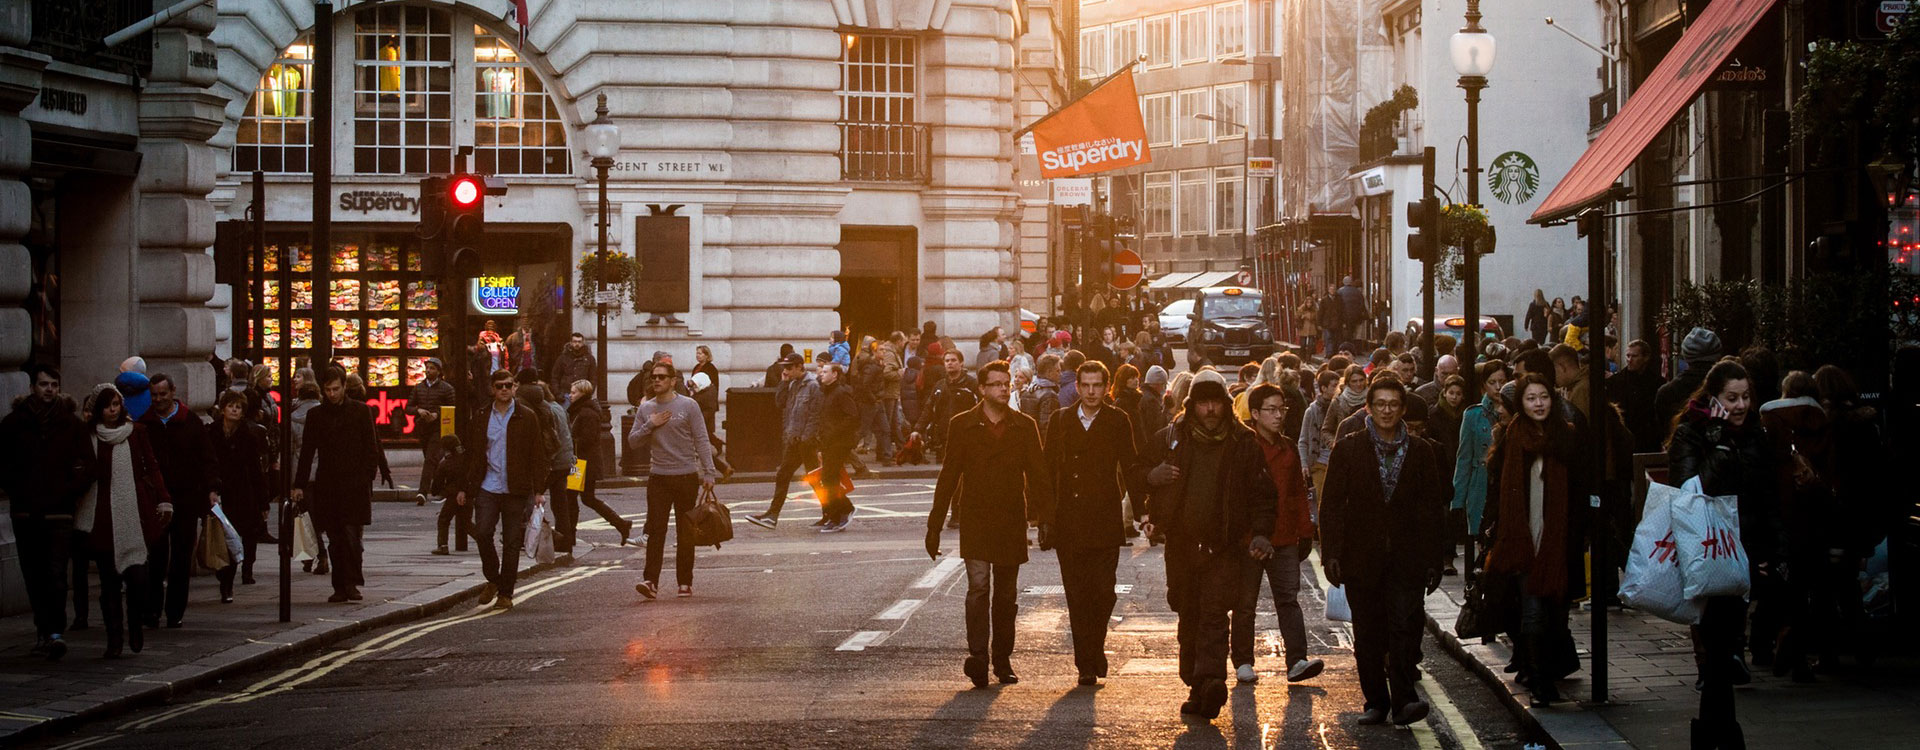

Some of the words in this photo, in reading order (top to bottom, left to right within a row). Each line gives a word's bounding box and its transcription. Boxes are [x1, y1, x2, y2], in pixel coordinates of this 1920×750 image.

[1042, 138, 1143, 172] Superdry
[658, 162, 701, 172] STREET
[339, 192, 420, 215] Superdry
[479, 276, 516, 288] T-SHIRT
[1860, 392, 1880, 400] AWAY
[1700, 525, 1740, 562] H&M
